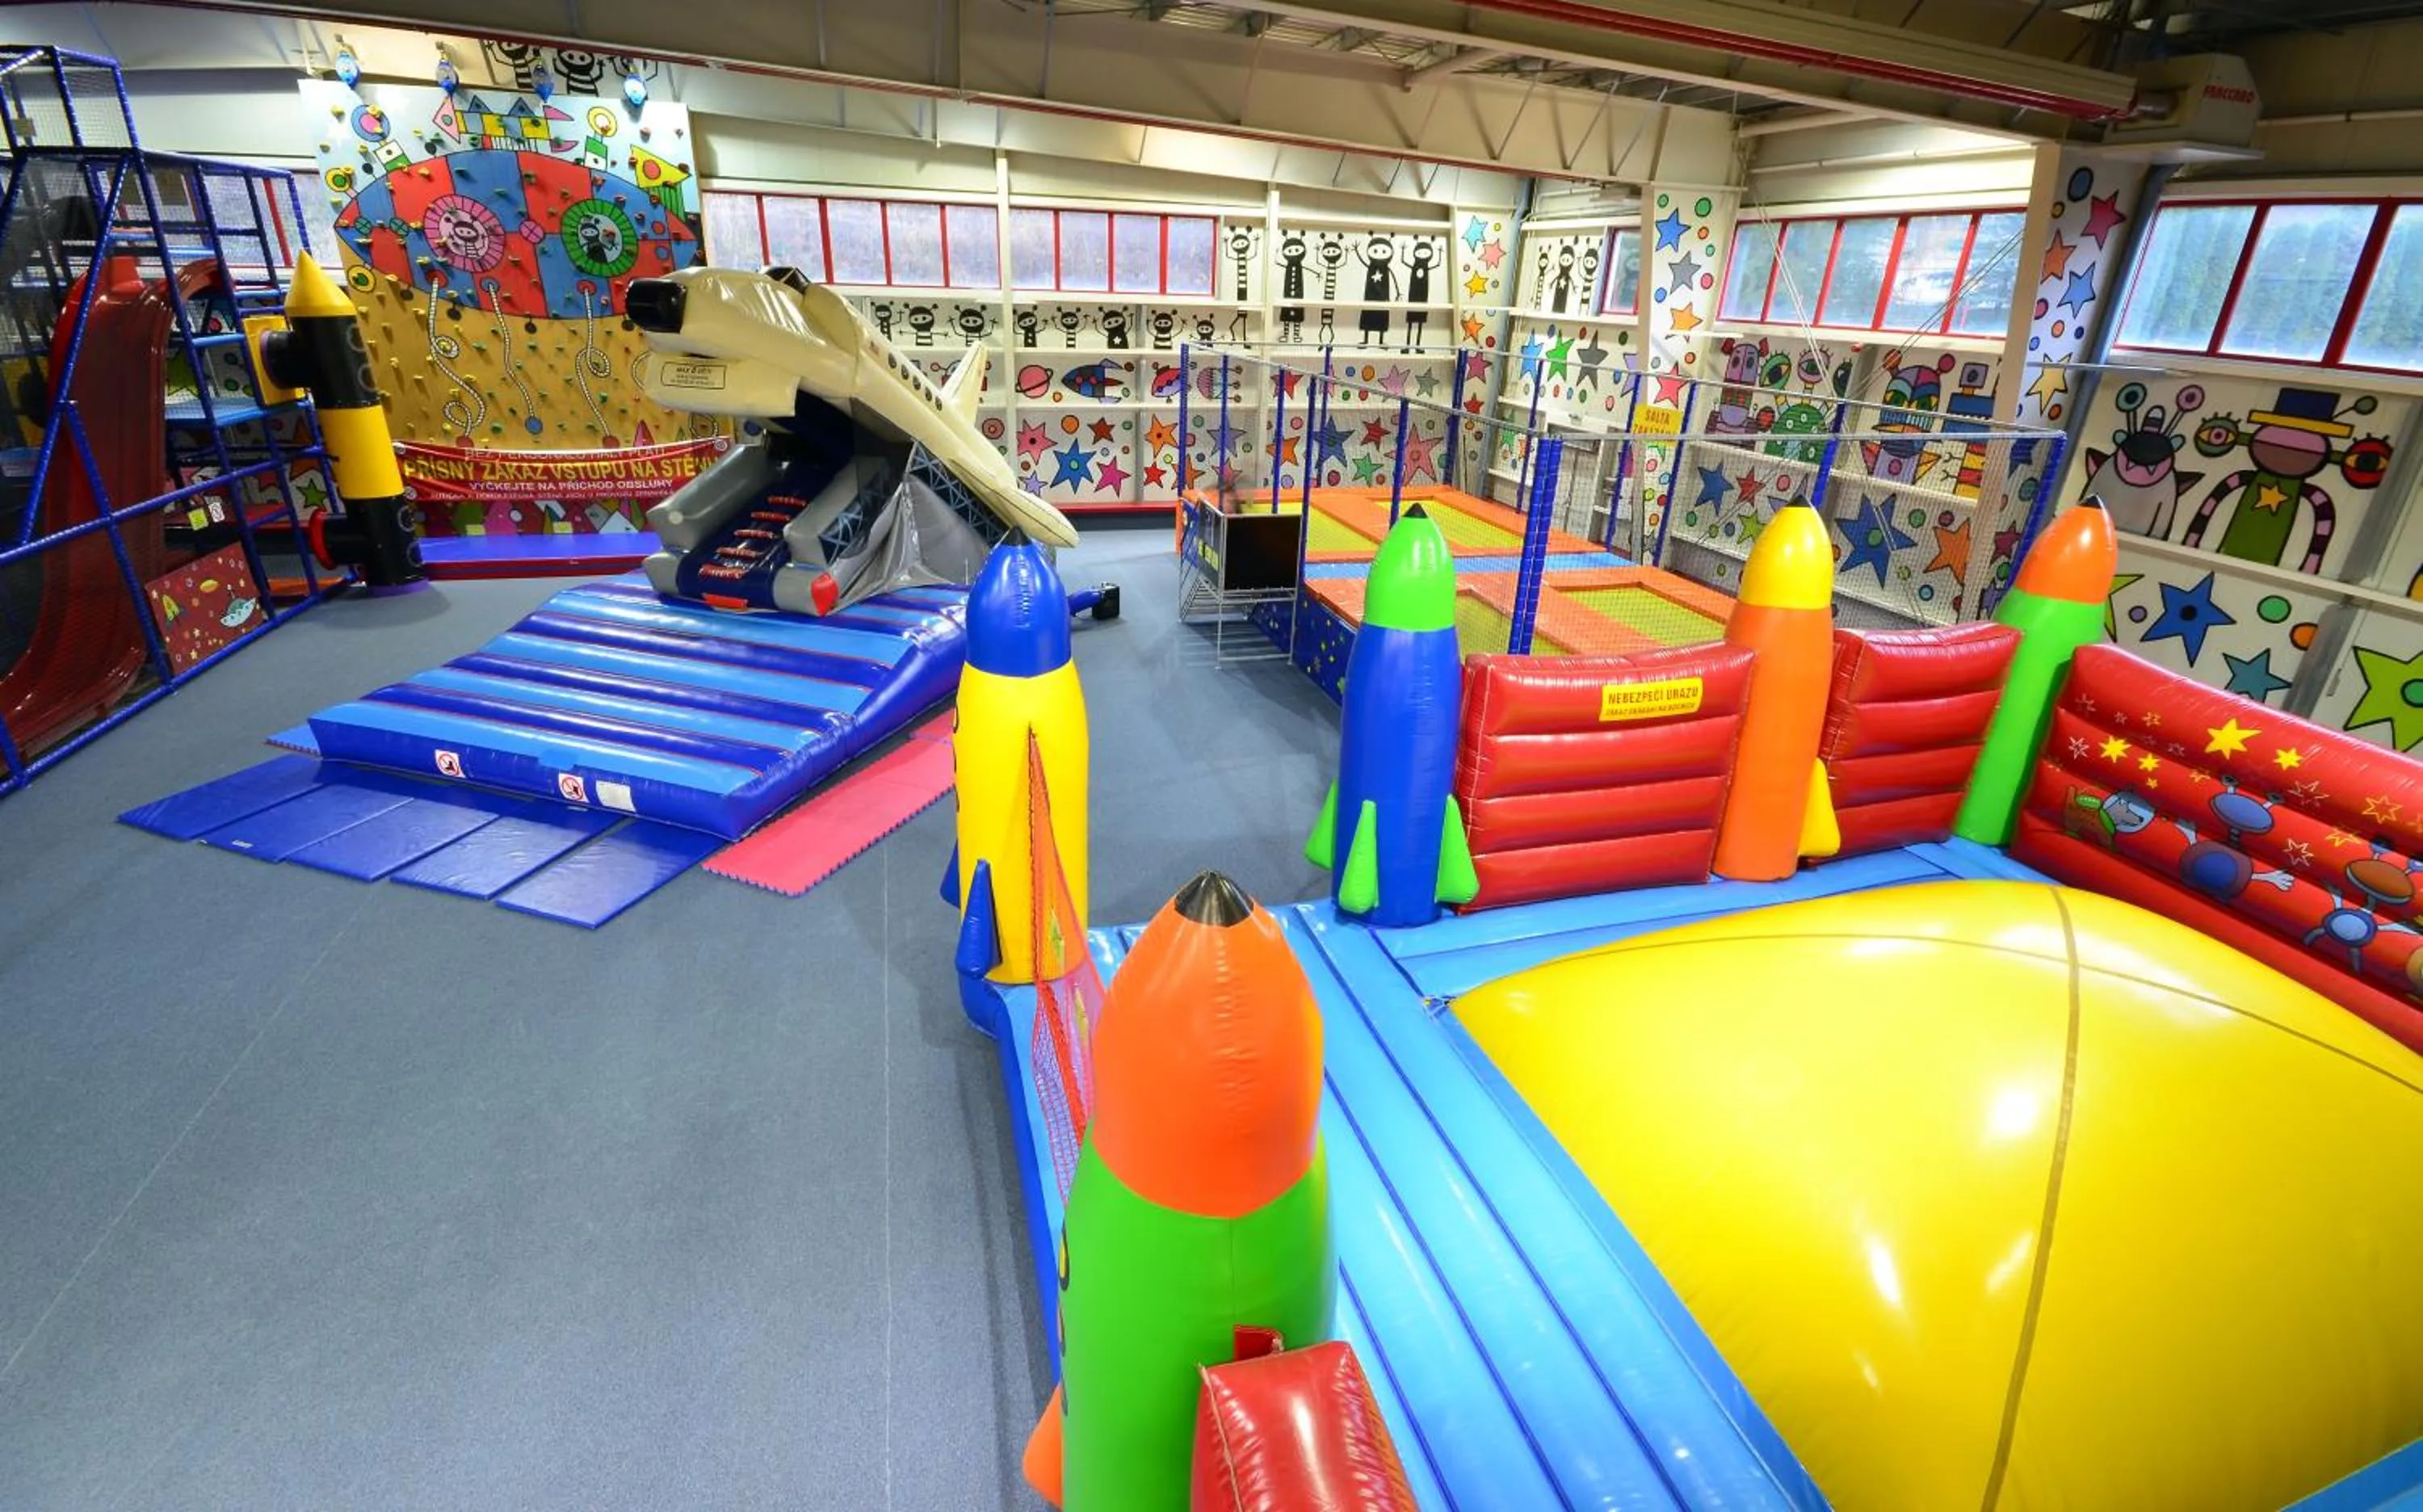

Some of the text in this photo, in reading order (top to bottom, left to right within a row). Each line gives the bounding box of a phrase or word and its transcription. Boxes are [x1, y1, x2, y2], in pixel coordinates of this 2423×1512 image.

[552, 461, 626, 480] VSTUPU
[631, 461, 659, 478] NA
[468, 480, 535, 490] VYČKEJTE
[538, 482, 556, 490] NA
[618, 479, 673, 489] OBSLUHY
